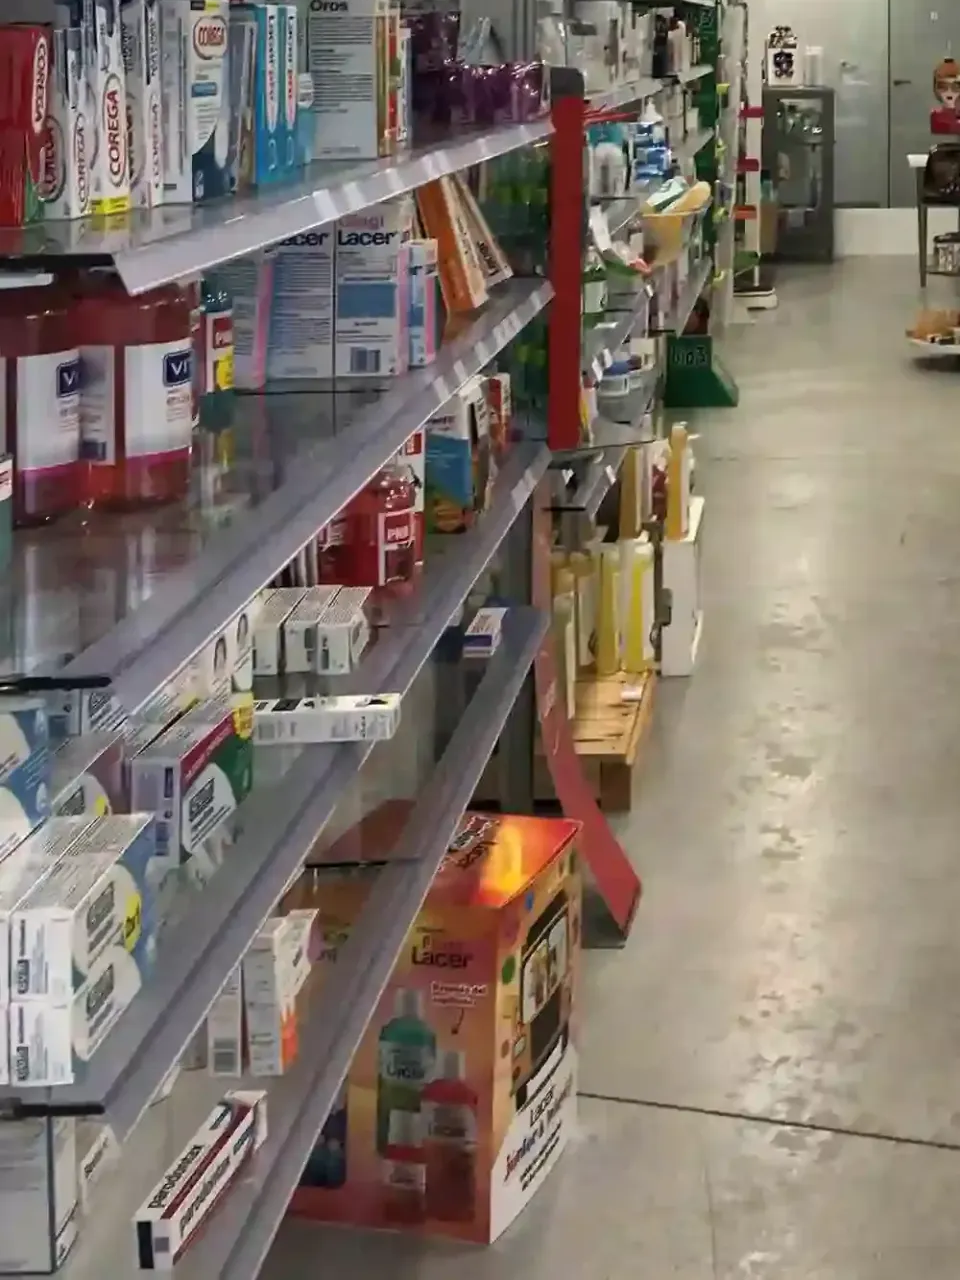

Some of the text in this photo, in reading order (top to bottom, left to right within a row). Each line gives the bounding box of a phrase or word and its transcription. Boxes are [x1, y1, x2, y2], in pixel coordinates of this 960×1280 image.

[310, 0, 349, 13] Oros
[34, 42, 47, 123] COREGA
[106, 88, 121, 176] COREGA
[278, 232, 329, 247] acer
[337, 230, 398, 246] Lacer
[411, 945, 475, 969] Lacer
[147, 1144, 206, 1210] parodontax
